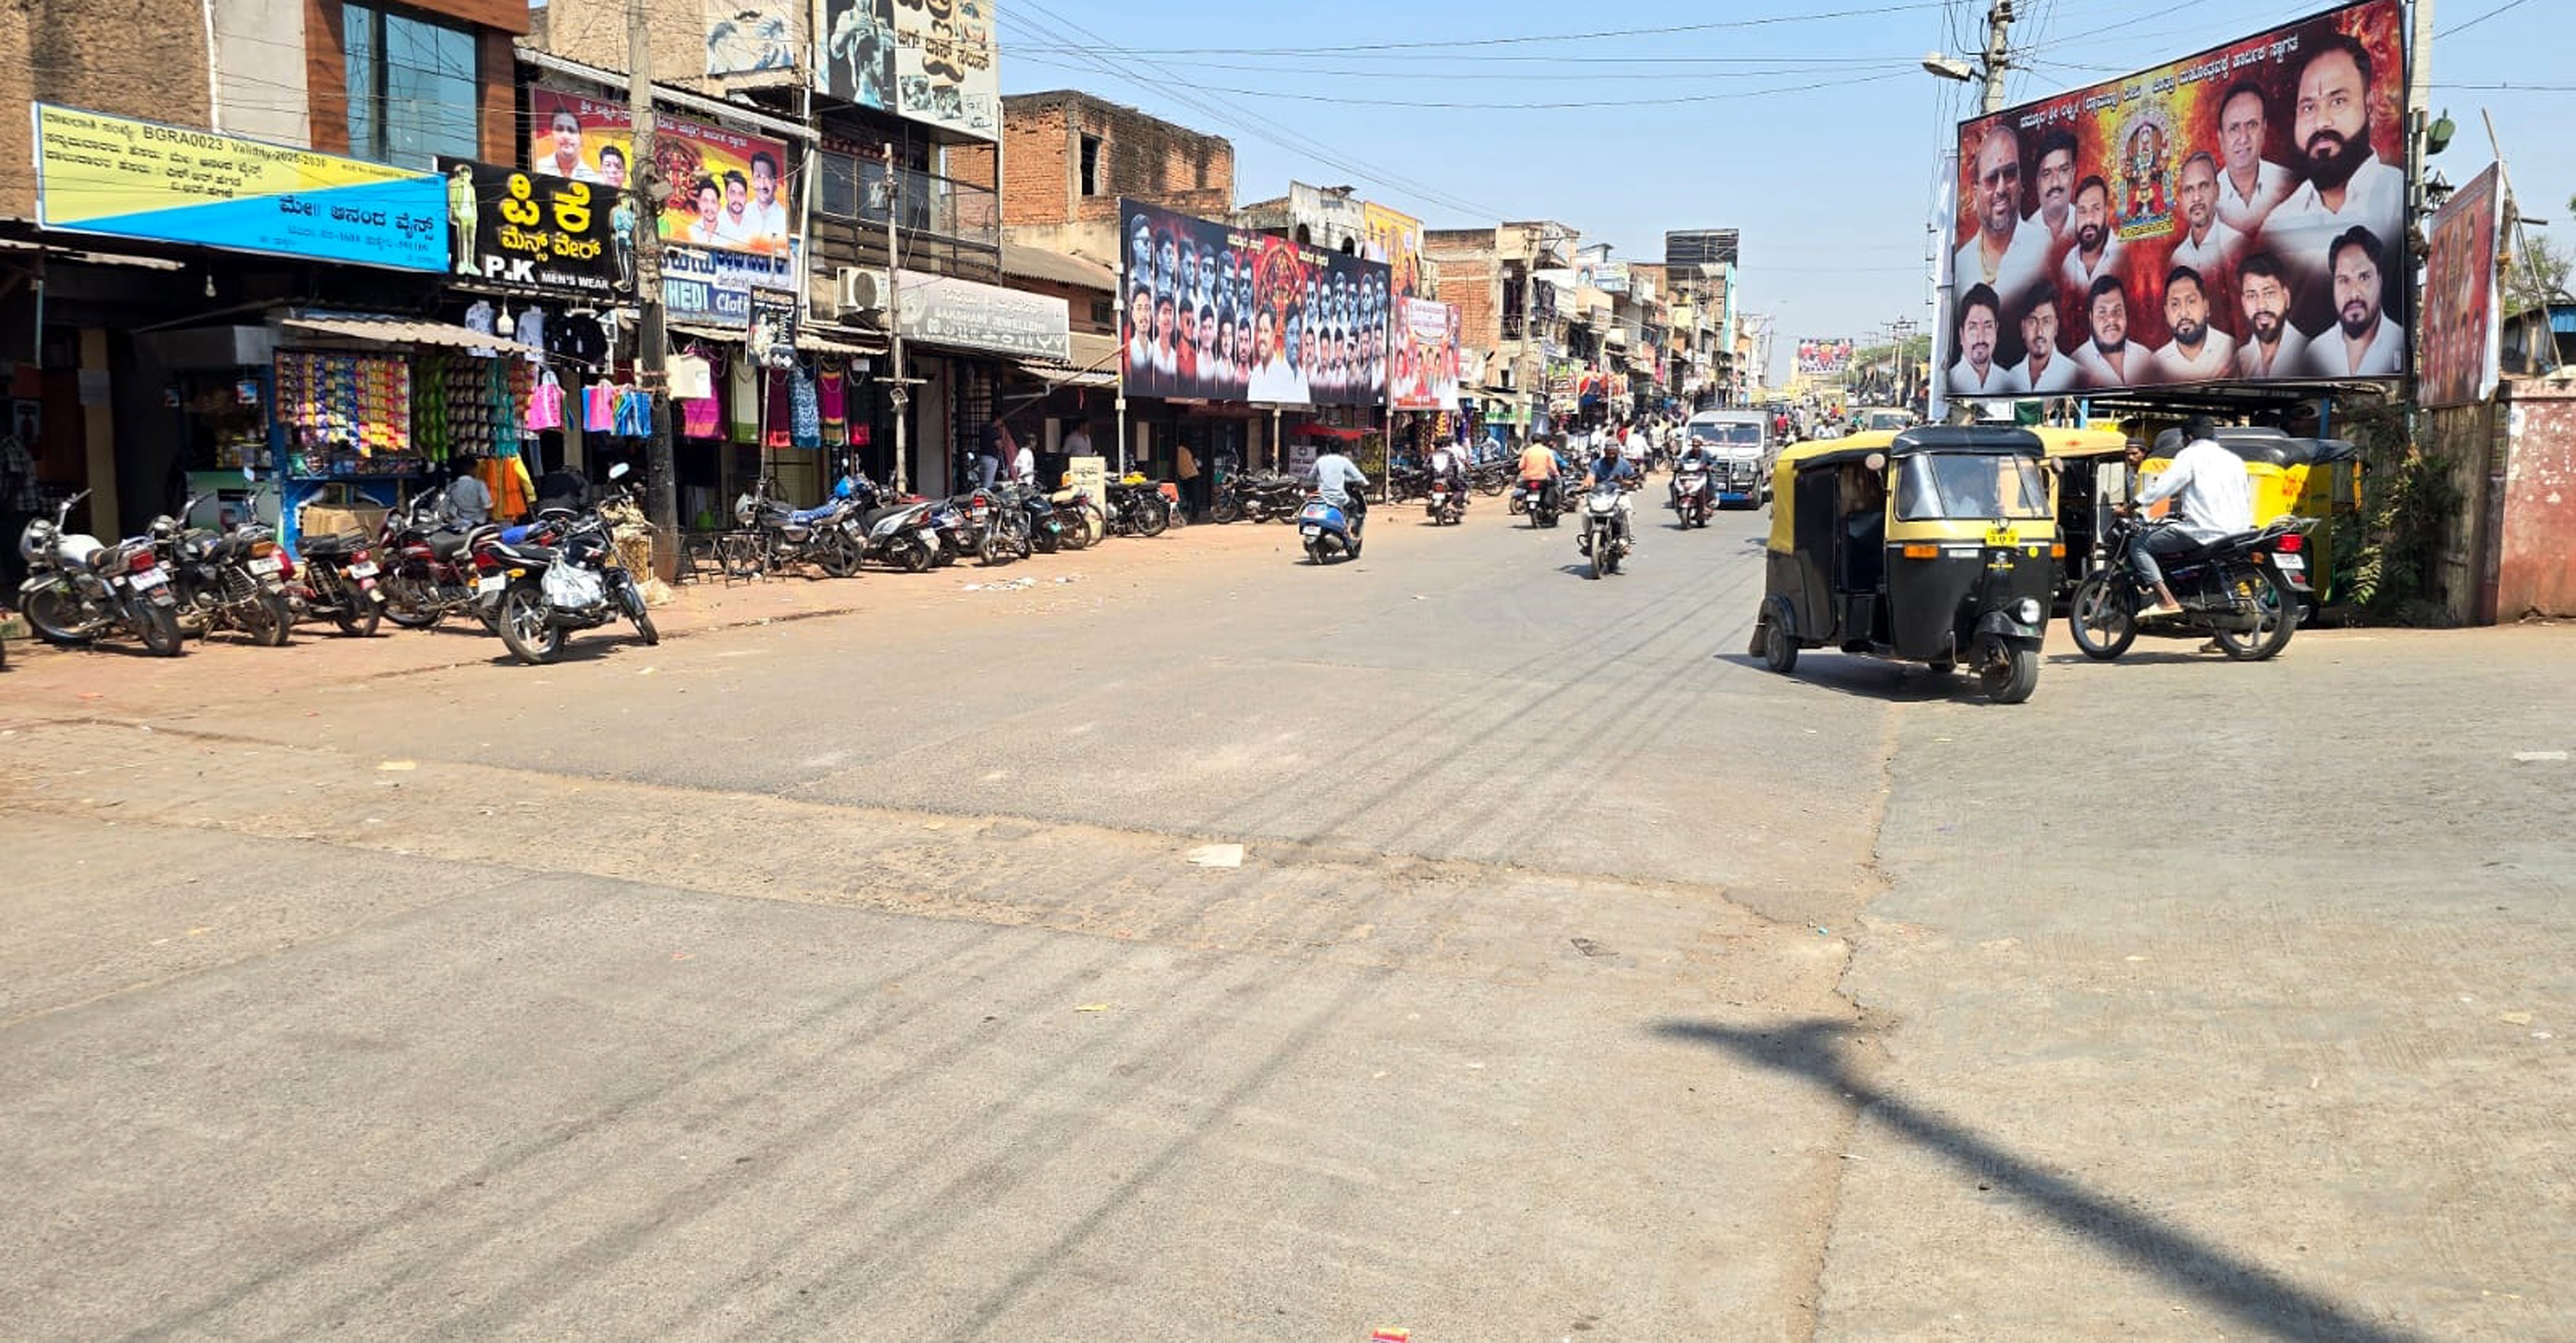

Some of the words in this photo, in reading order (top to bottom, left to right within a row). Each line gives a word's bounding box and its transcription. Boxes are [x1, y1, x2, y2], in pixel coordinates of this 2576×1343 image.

[143, 125, 223, 151] BGRA0023
[500, 173, 540, 226] ಪಿ
[552, 181, 591, 233] ಕೆ
[331, 205, 386, 226] ಆನಂದ
[395, 213, 434, 242] ವೈನ್ಸ್
[500, 225, 549, 262] ಮೆನ್ಸ್
[553, 233, 601, 259] ವೇರ್
[485, 254, 535, 283] P.K
[542, 272, 575, 286] MEN'S
[578, 276, 609, 289] WEAR
[663, 279, 708, 312] HEDI
